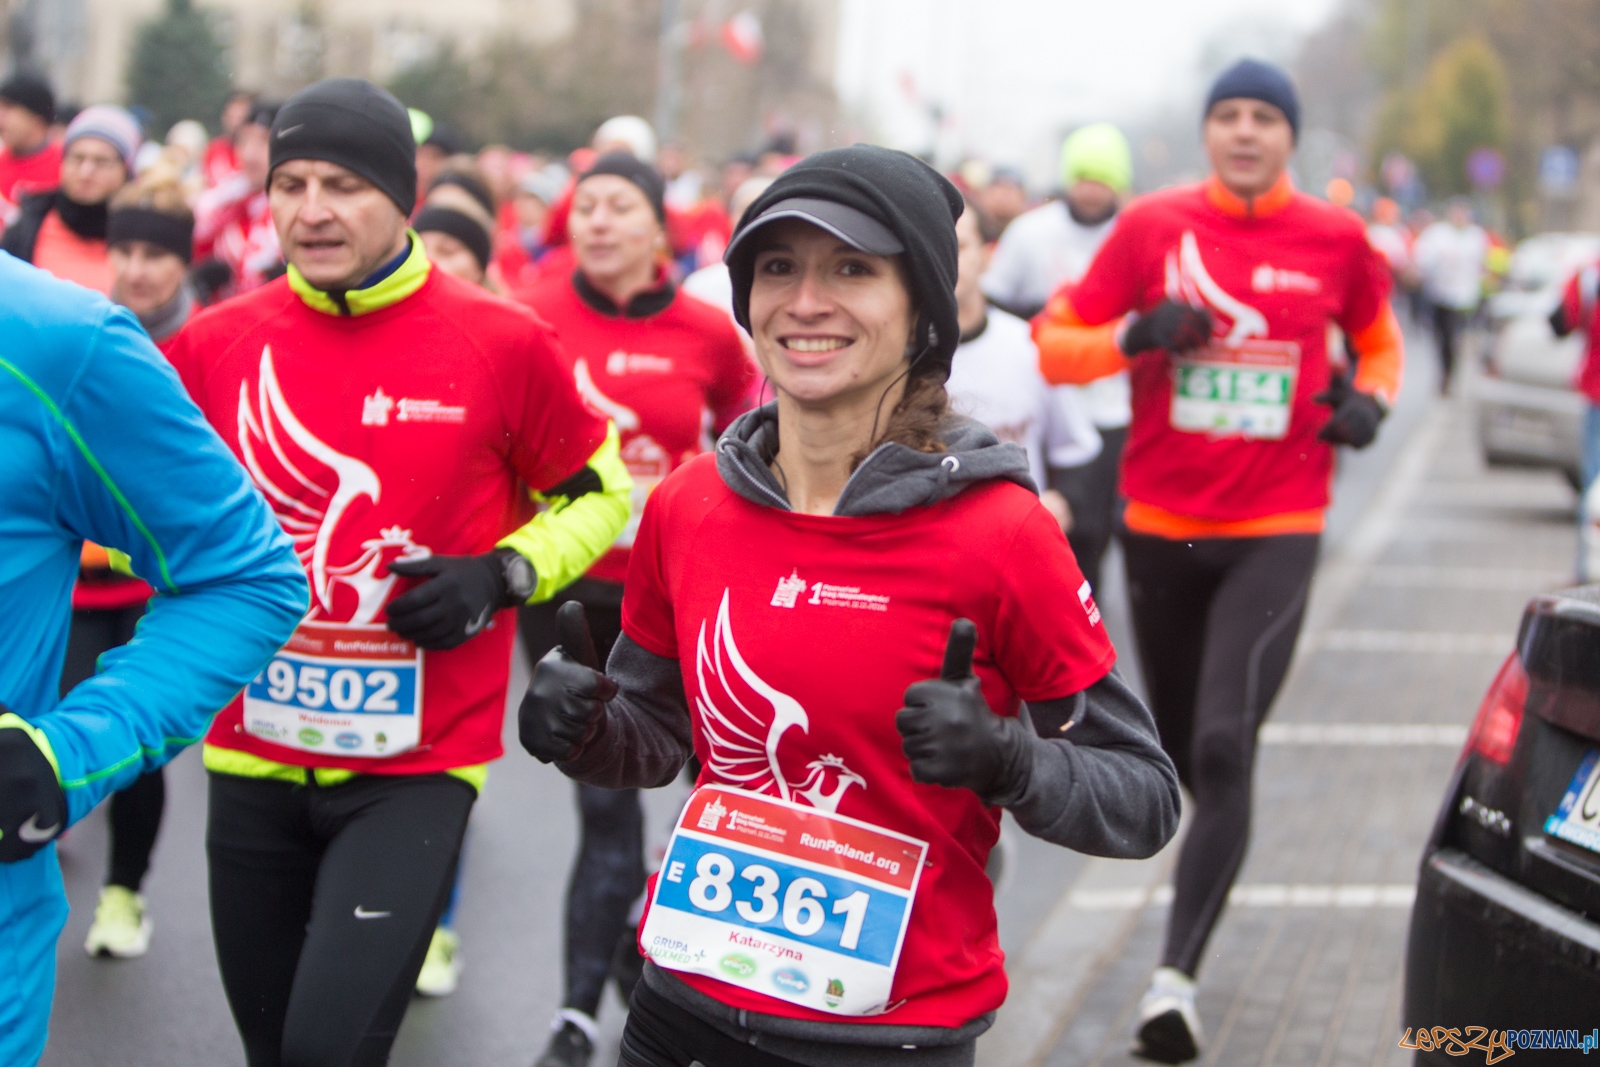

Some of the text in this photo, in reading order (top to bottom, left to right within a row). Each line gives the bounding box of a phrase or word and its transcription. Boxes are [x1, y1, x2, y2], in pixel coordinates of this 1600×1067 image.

[1188, 368, 1282, 404] 6154
[808, 581, 823, 605] 1
[267, 660, 400, 712] 9502
[725, 809, 739, 831] 1
[799, 832, 901, 876] RunPoland.org
[666, 851, 871, 951] E 8361
[648, 945, 692, 965] LUXMED
[652, 935, 689, 953] GRUPA
[728, 931, 803, 962] Katarzyna
